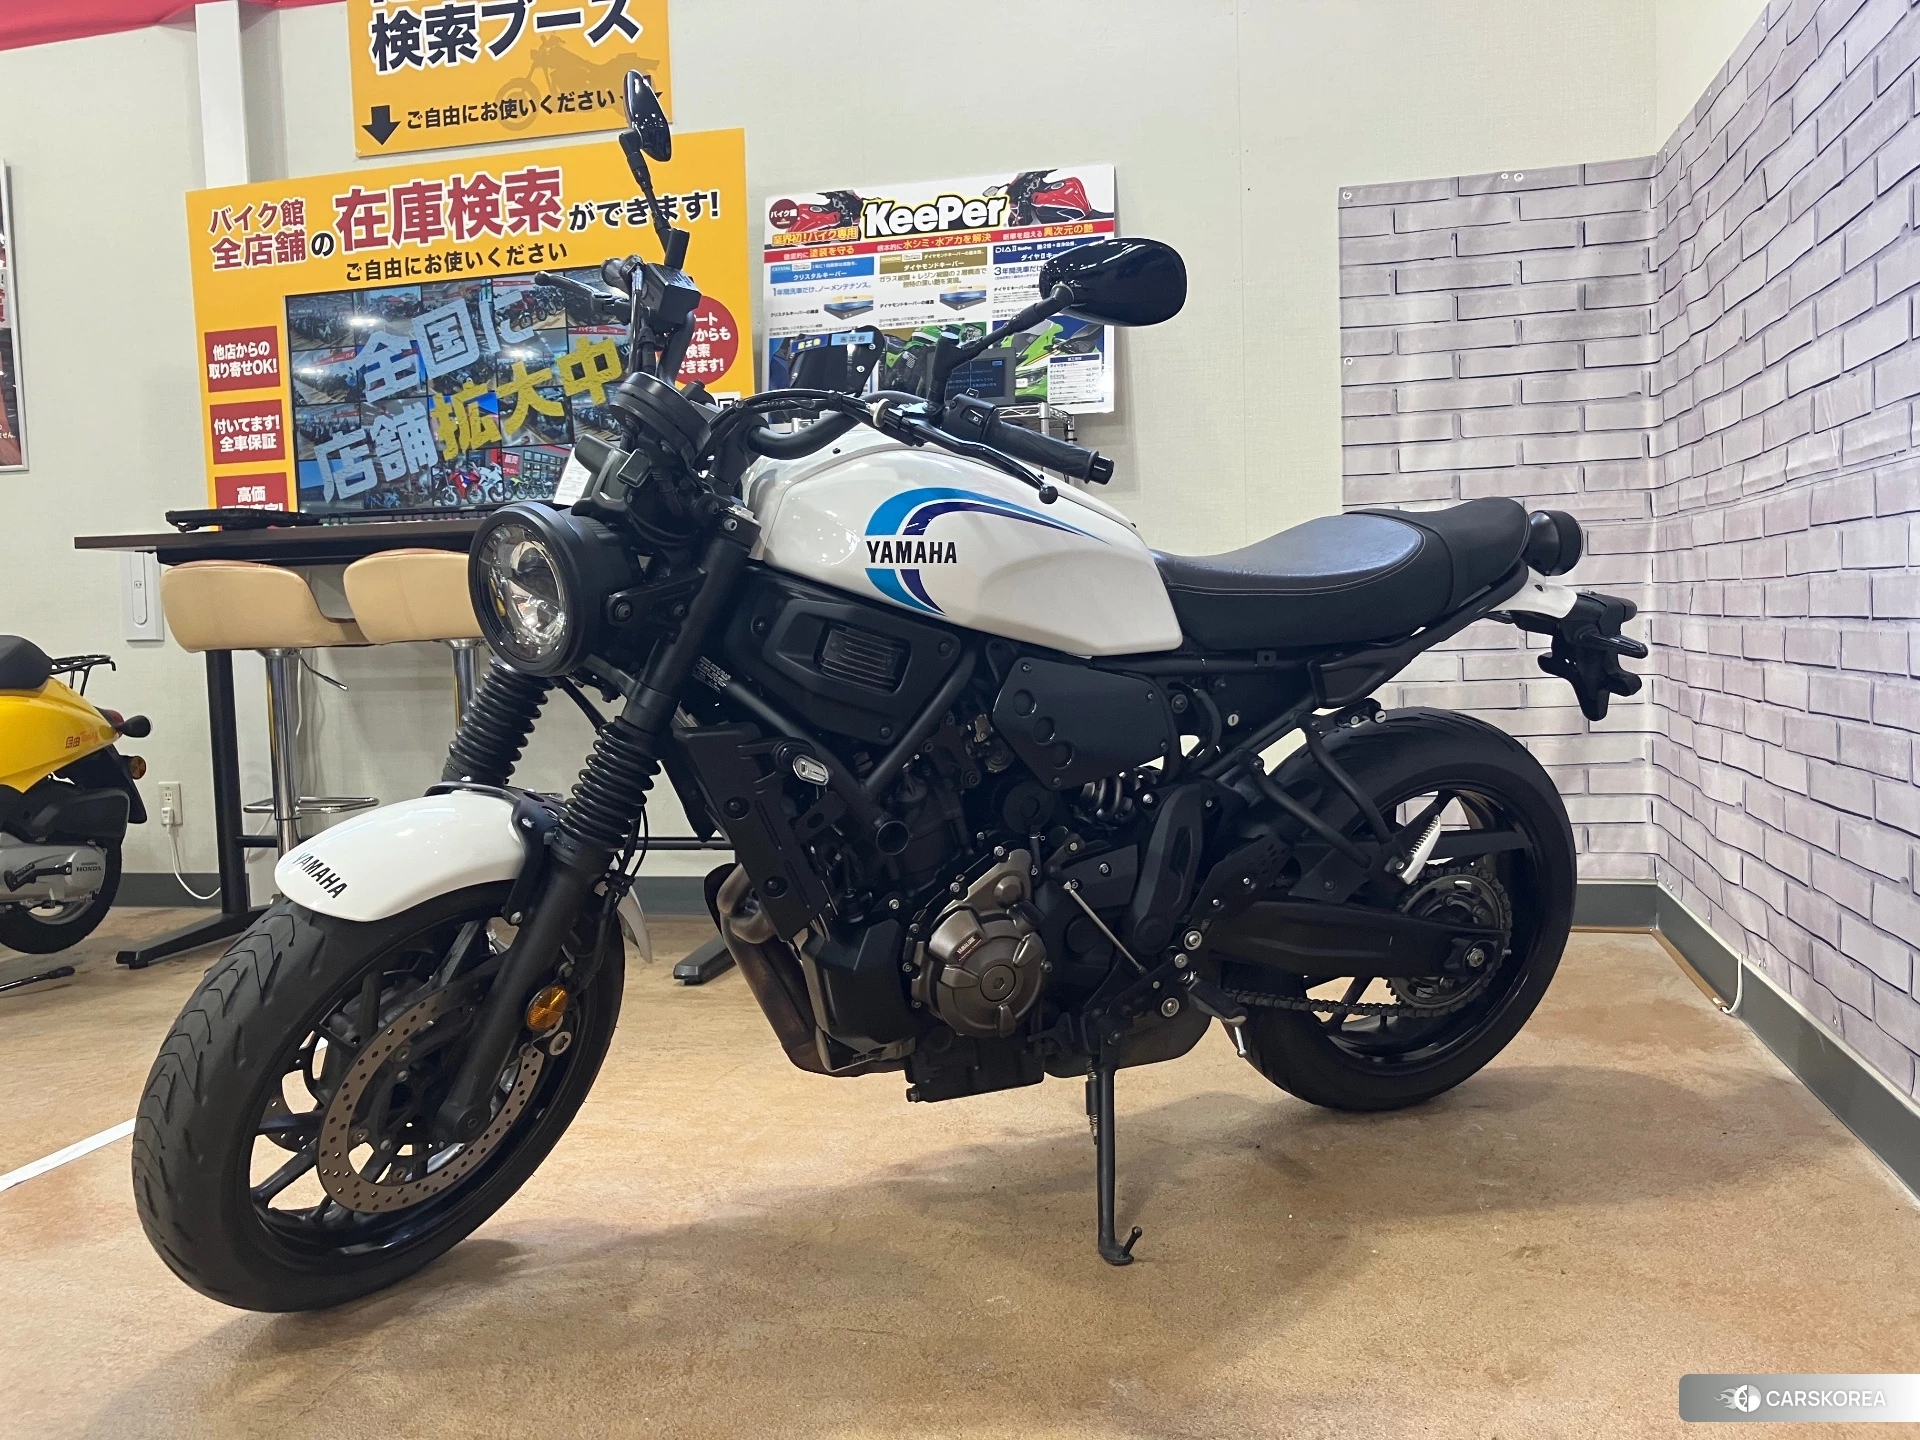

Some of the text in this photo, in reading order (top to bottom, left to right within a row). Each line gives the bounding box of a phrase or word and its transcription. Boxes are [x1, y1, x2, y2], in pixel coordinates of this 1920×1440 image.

[371, 0, 641, 73] 検索ブース
[406, 89, 615, 130] ご自由にお使いください
[208, 198, 306, 234] バイク館
[864, 197, 1006, 238] KeePer
[211, 230, 307, 270] 全店舗
[345, 243, 568, 282] ご自由にお使いください
[904, 261, 964, 271] ダイヤモンドキーパー
[793, 271, 847, 281] クリスタルキーパー
[694, 311, 718, 326] ート
[212, 341, 270, 361] 他店からの
[355, 290, 535, 403] 全国に
[686, 343, 711, 359] 検索
[208, 358, 278, 380] 取り寄せOK!
[214, 415, 280, 436] 付いてます!
[220, 434, 277, 453] 全車保証
[237, 486, 266, 503] 高価
[866, 540, 957, 564] YAMAHA
[292, 852, 348, 899] YAMAHA
